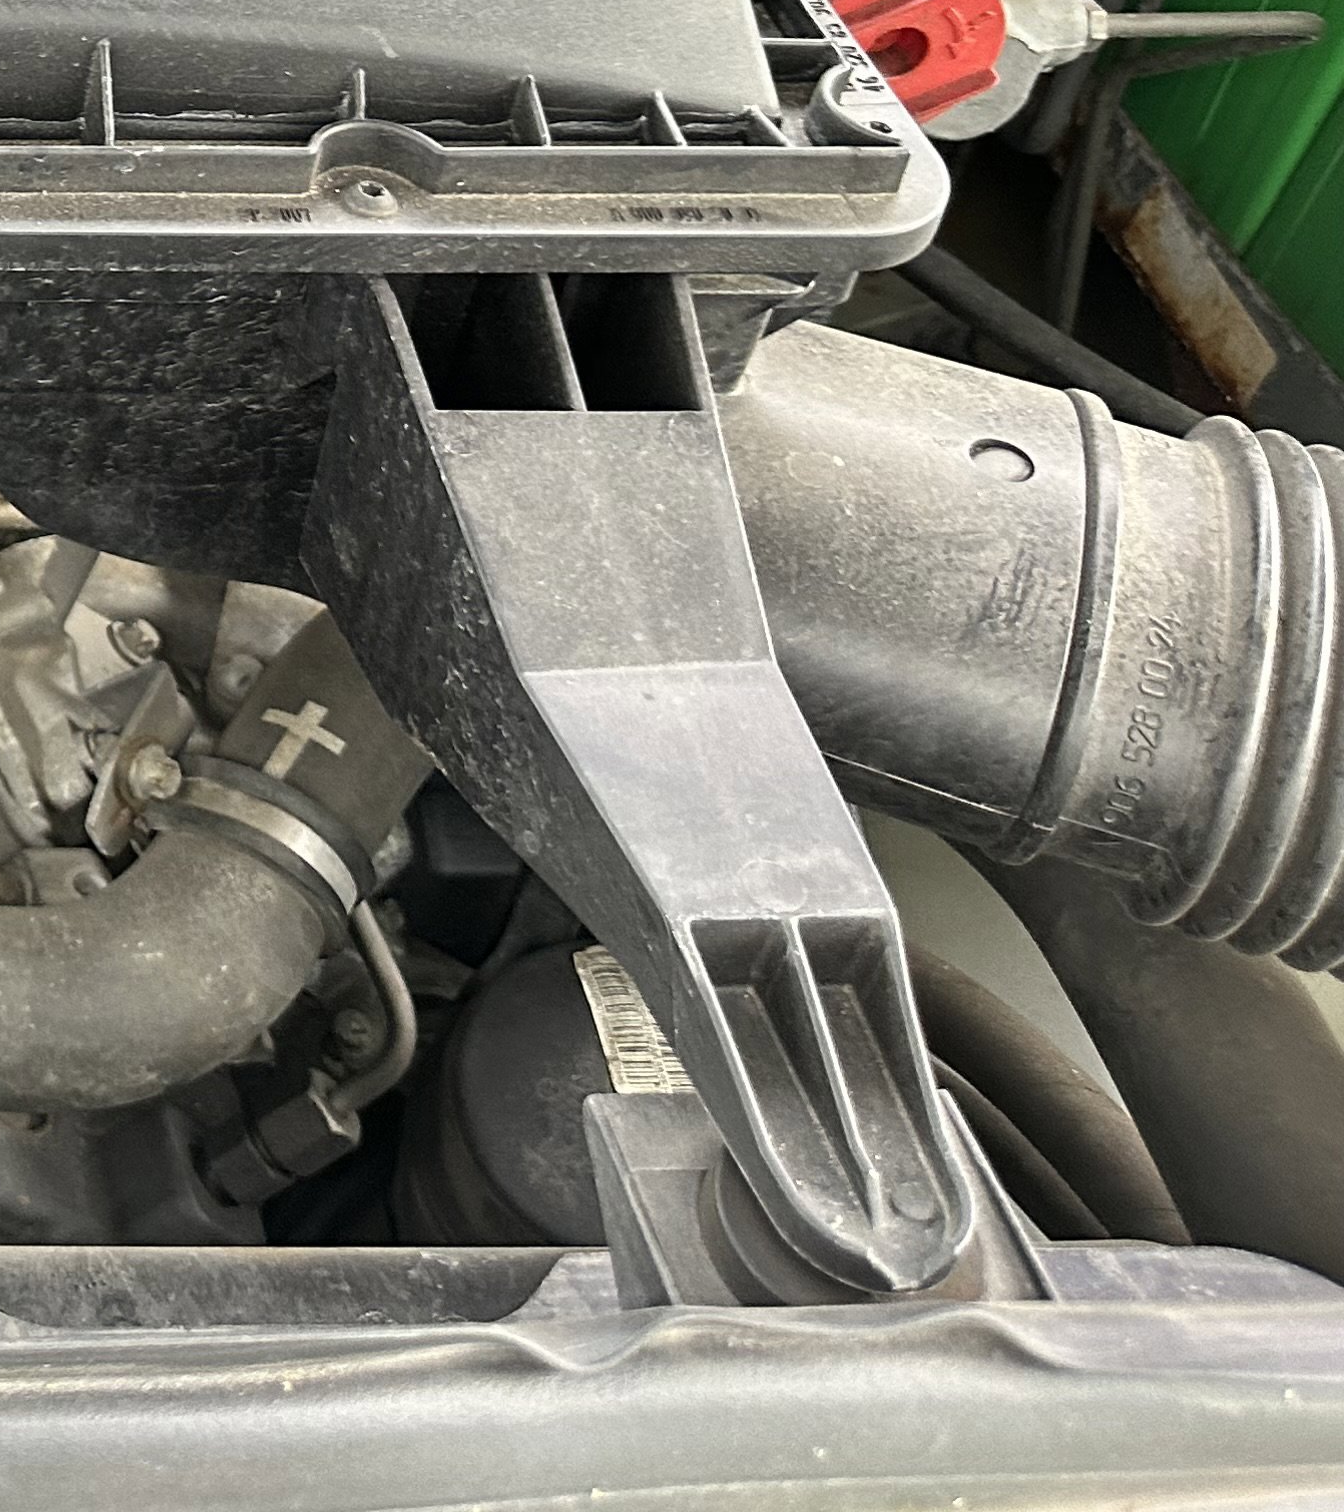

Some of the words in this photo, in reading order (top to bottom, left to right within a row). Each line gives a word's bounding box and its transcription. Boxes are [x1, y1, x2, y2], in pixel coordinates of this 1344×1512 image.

[1149, 609, 1183, 652] 24
[1141, 657, 1175, 701] 00
[1121, 705, 1164, 768] 528
[1099, 775, 1147, 828] 906
